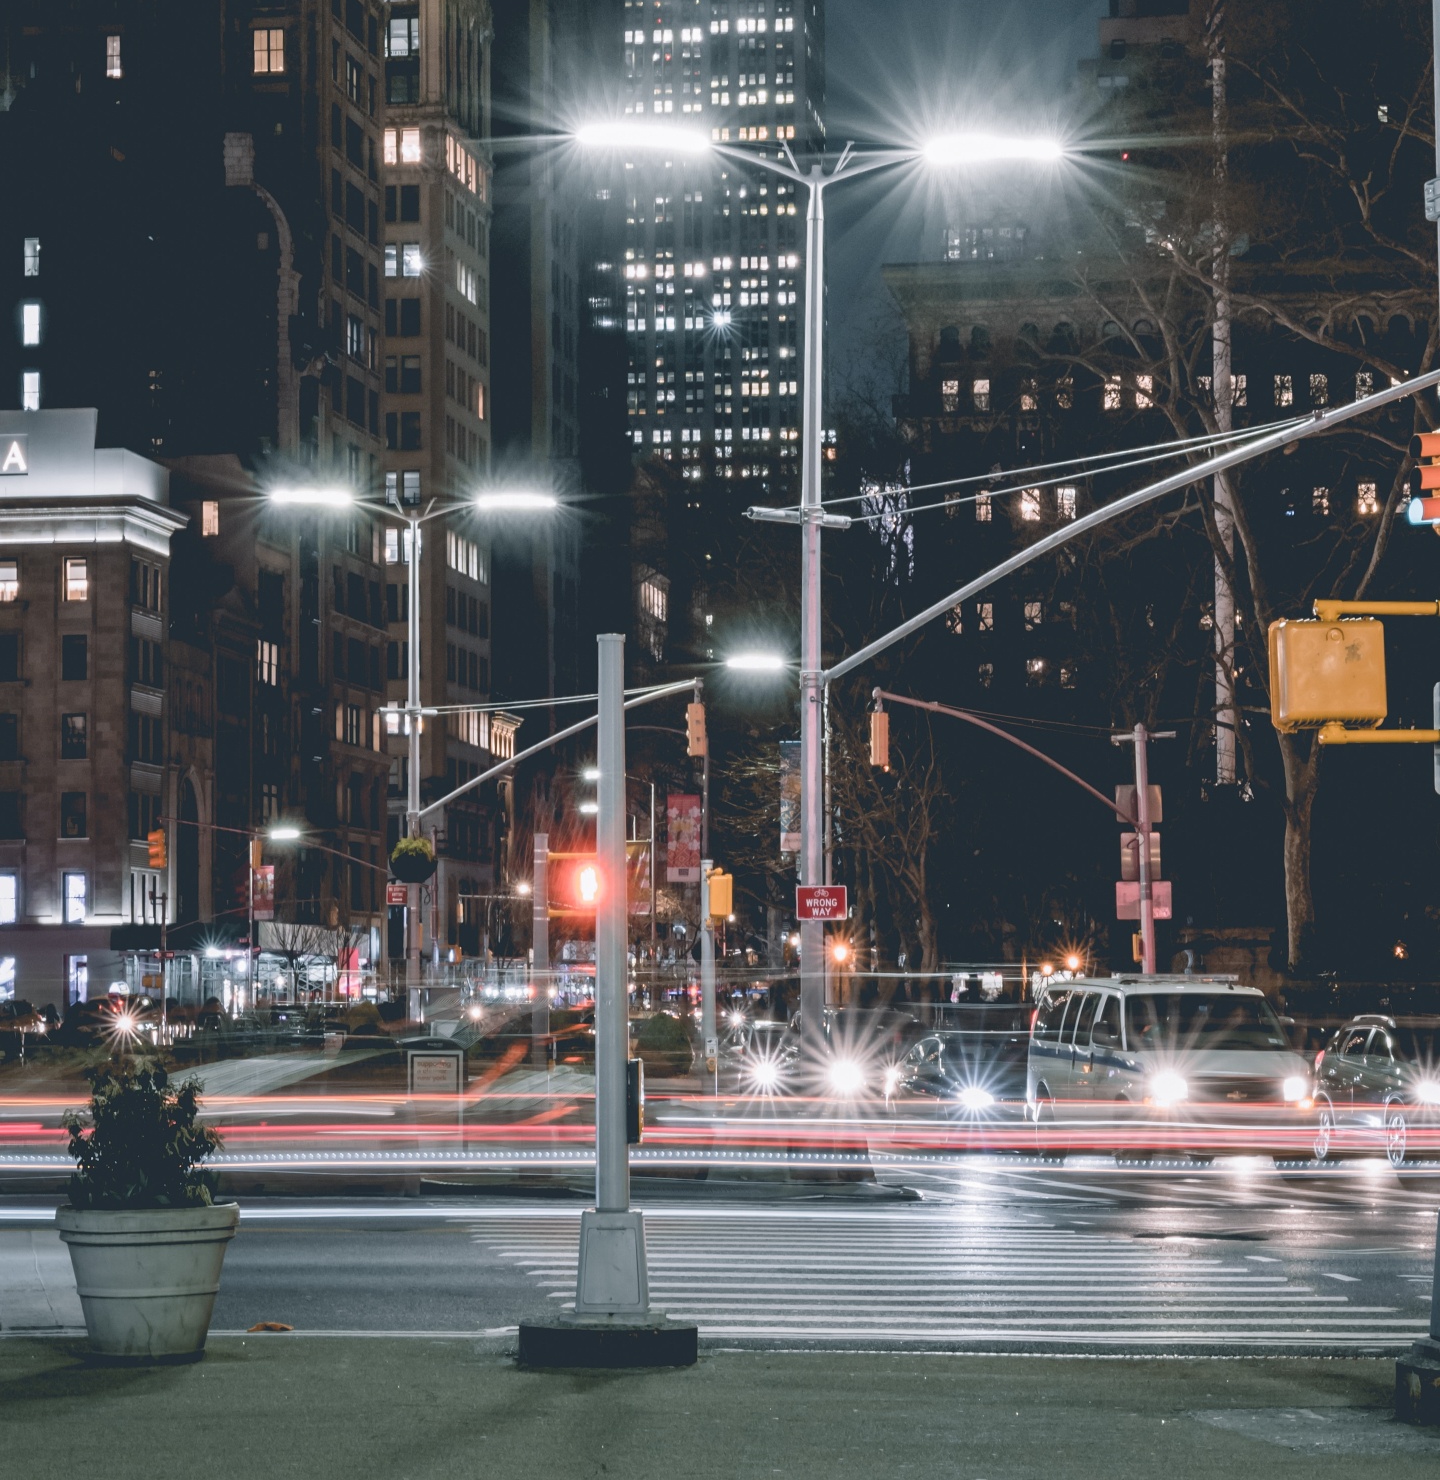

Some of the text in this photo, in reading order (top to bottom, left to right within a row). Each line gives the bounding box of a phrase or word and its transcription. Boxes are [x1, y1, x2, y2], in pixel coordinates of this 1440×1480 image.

[3, 440, 27, 471] A
[806, 898, 837, 907] WRONG
[812, 907, 832, 916] WAY
